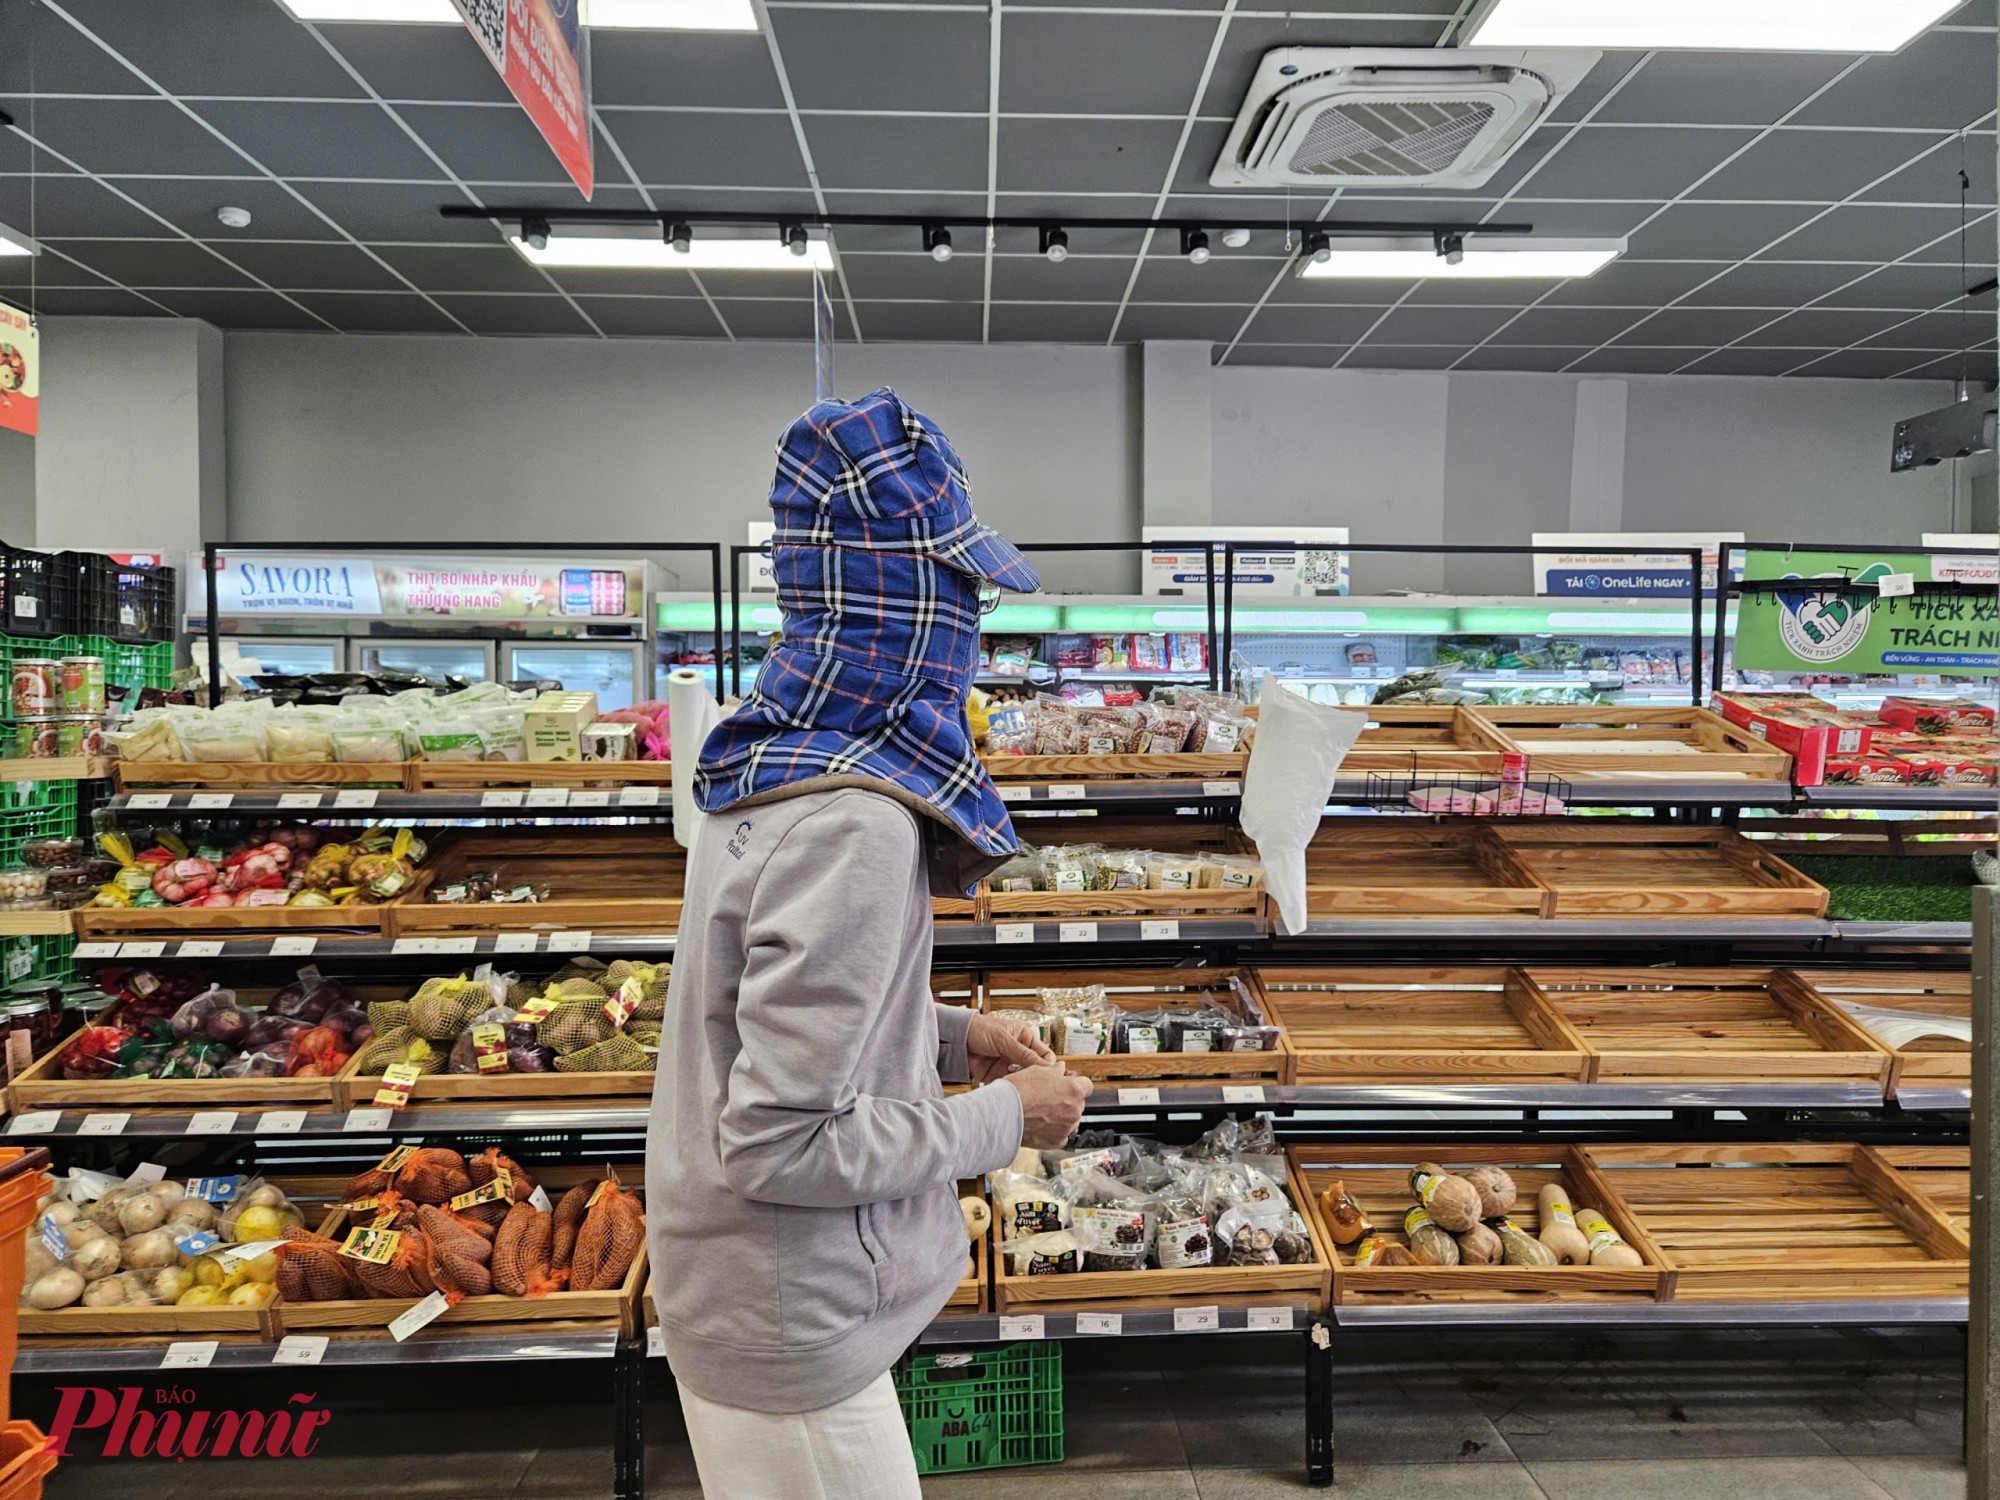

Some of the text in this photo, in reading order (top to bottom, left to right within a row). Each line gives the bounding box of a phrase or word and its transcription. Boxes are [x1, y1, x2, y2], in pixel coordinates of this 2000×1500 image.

[241, 563, 354, 597] SAVORA
[408, 568, 537, 587] THỊT BÒ NHẬP KHẨU
[1565, 574, 1684, 589] TẢI OneLife NGAY
[408, 594, 501, 611] THƯỢNG HẠNG
[1785, 621, 1795, 640] TICK
[1792, 639, 1813, 655] XANH
[1890, 624, 1969, 647] TRÁCH
[738, 832, 749, 846] UV
[1100, 1320, 1110, 1328] 16
[1197, 1315, 1208, 1323] 29
[1270, 1316, 1281, 1324] 32
[1021, 1325, 1033, 1333] 56
[941, 1420, 970, 1438] ABA
[971, 1414, 992, 1434] 64
